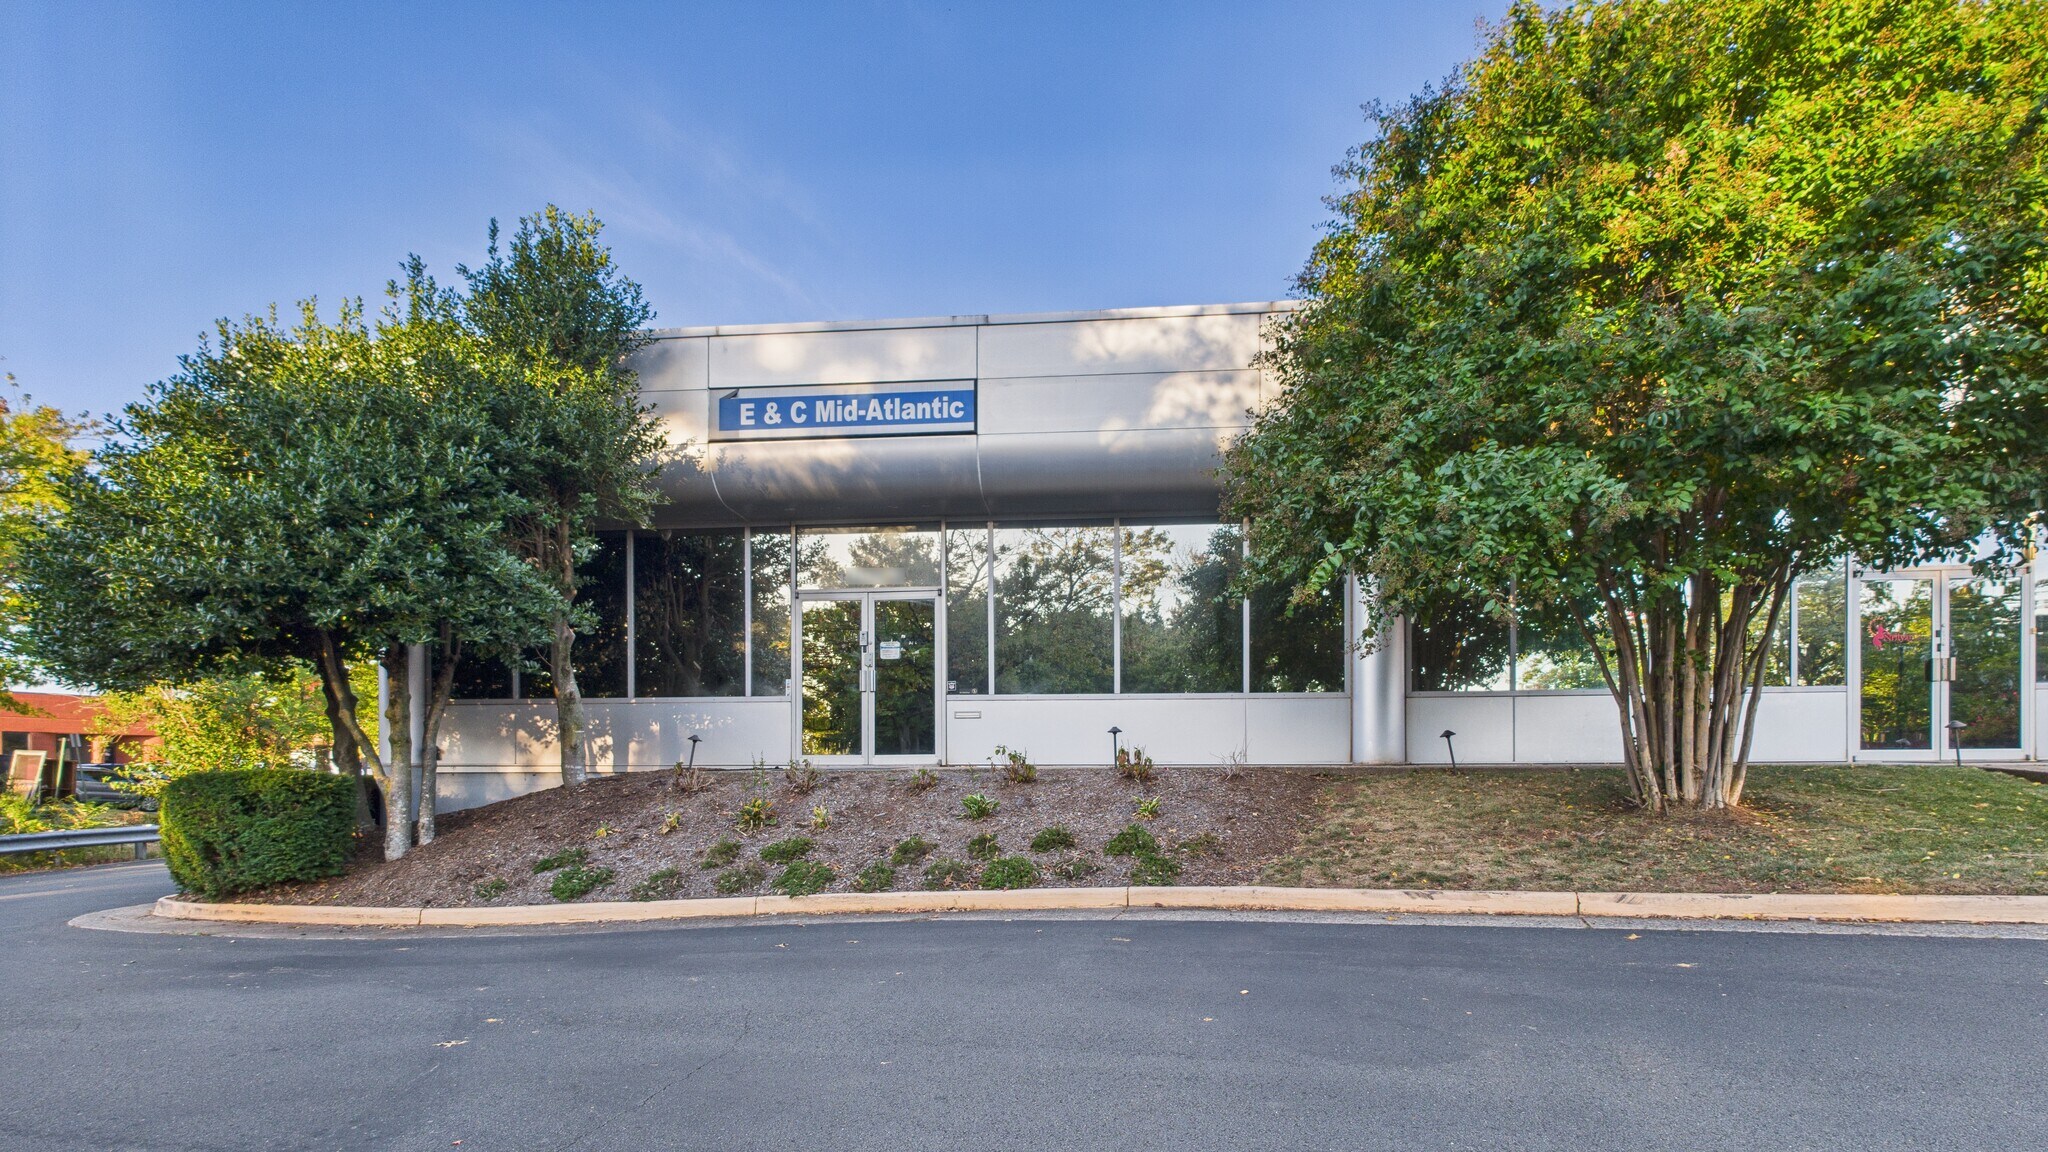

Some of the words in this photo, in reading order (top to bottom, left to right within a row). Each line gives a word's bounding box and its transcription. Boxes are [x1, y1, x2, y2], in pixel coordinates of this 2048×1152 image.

[739, 403, 756, 426] E
[764, 401, 782, 425] &
[790, 400, 807, 424] C
[815, 395, 965, 423] Mid-Atlantic
